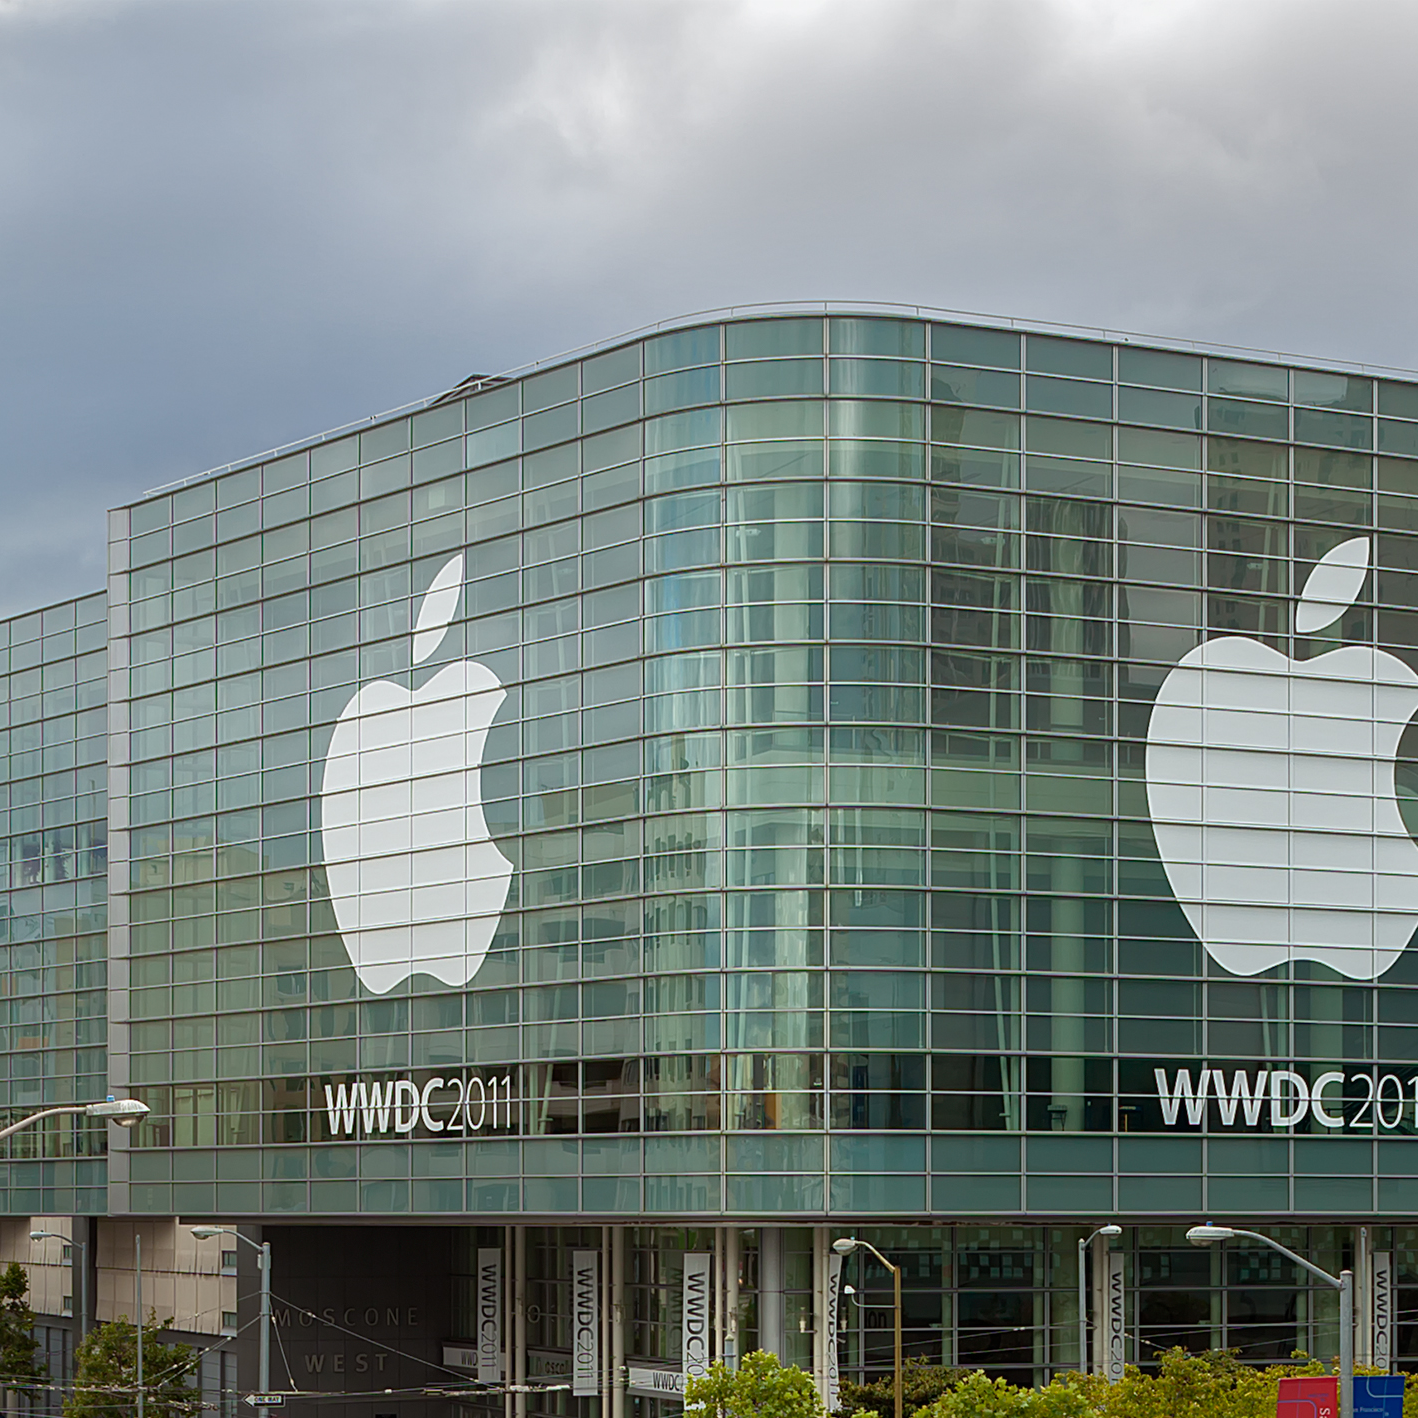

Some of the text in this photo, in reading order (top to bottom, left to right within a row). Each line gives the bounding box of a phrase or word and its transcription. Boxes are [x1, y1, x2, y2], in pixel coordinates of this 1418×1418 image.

[324, 1075, 512, 1135] WWDC2011
[274, 1307, 418, 1327] MOSCONE
[480, 1263, 497, 1368] WWDC2011
[577, 1267, 594, 1379] WWDC2011
[686, 1271, 706, 1377] WWDC20
[304, 1354, 388, 1373] WEST
